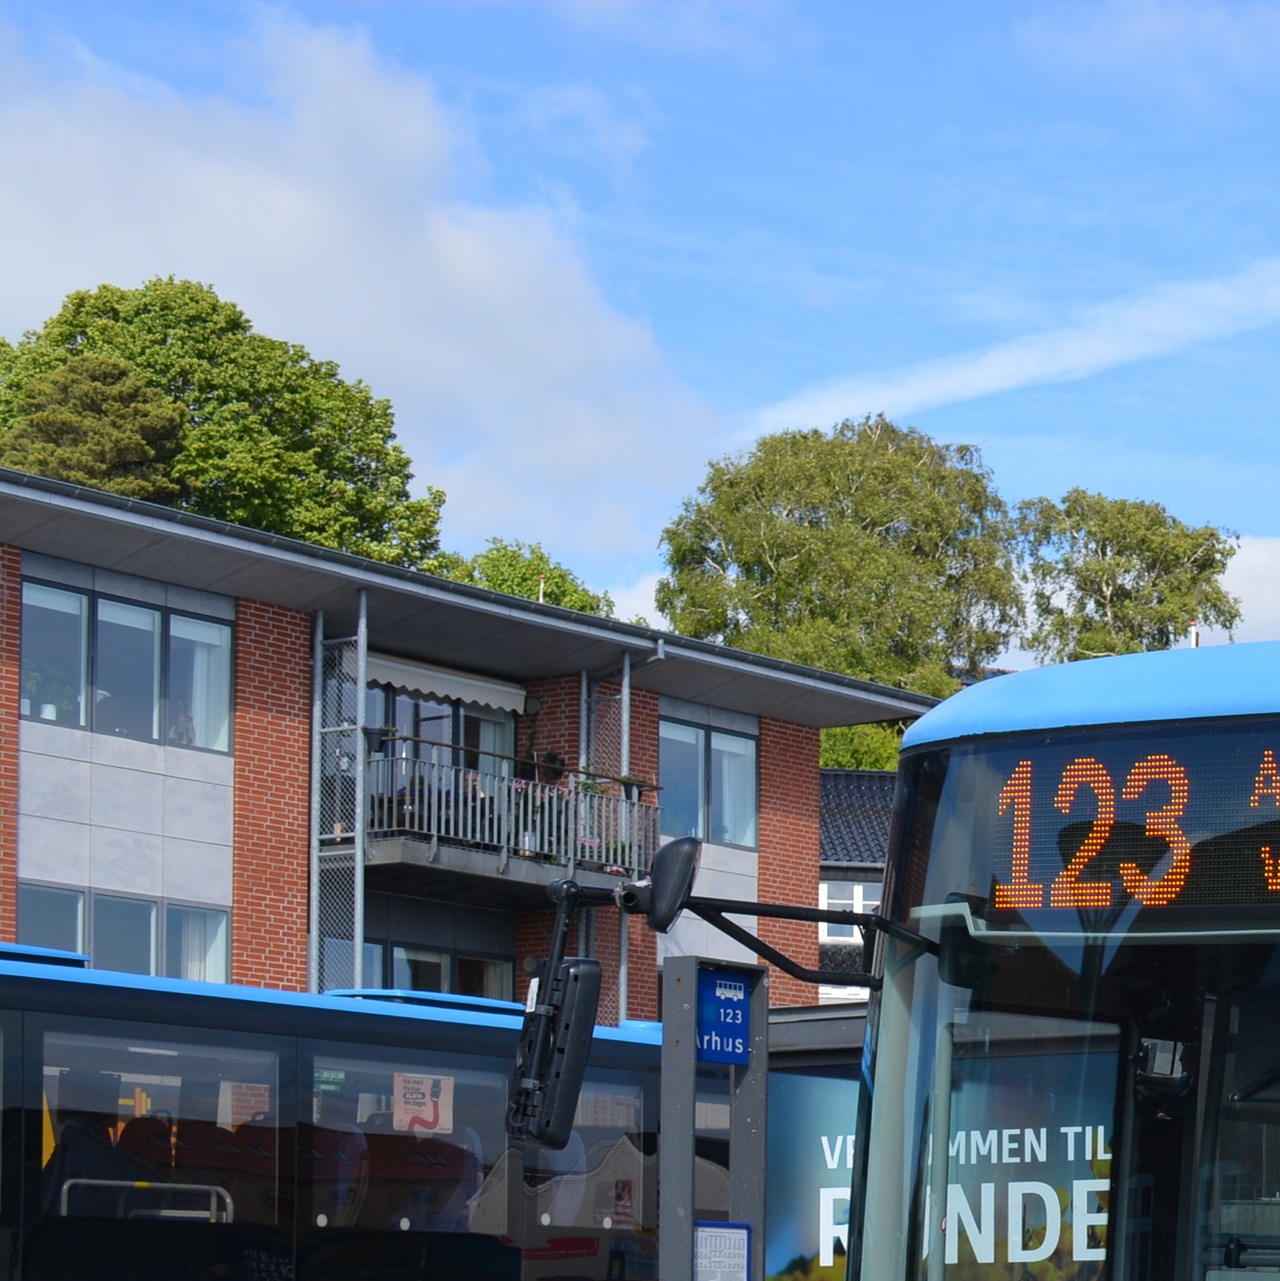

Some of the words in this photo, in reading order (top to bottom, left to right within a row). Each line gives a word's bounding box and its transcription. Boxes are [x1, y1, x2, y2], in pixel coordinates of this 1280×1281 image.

[995, 755, 1191, 909] 123
[720, 1008, 742, 1024] 123
[696, 1030, 744, 1053] rhus
[820, 1127, 1047, 1169] VMMEN
[1060, 1125, 1112, 1161] TIL
[818, 1178, 1111, 1267] RNDE
